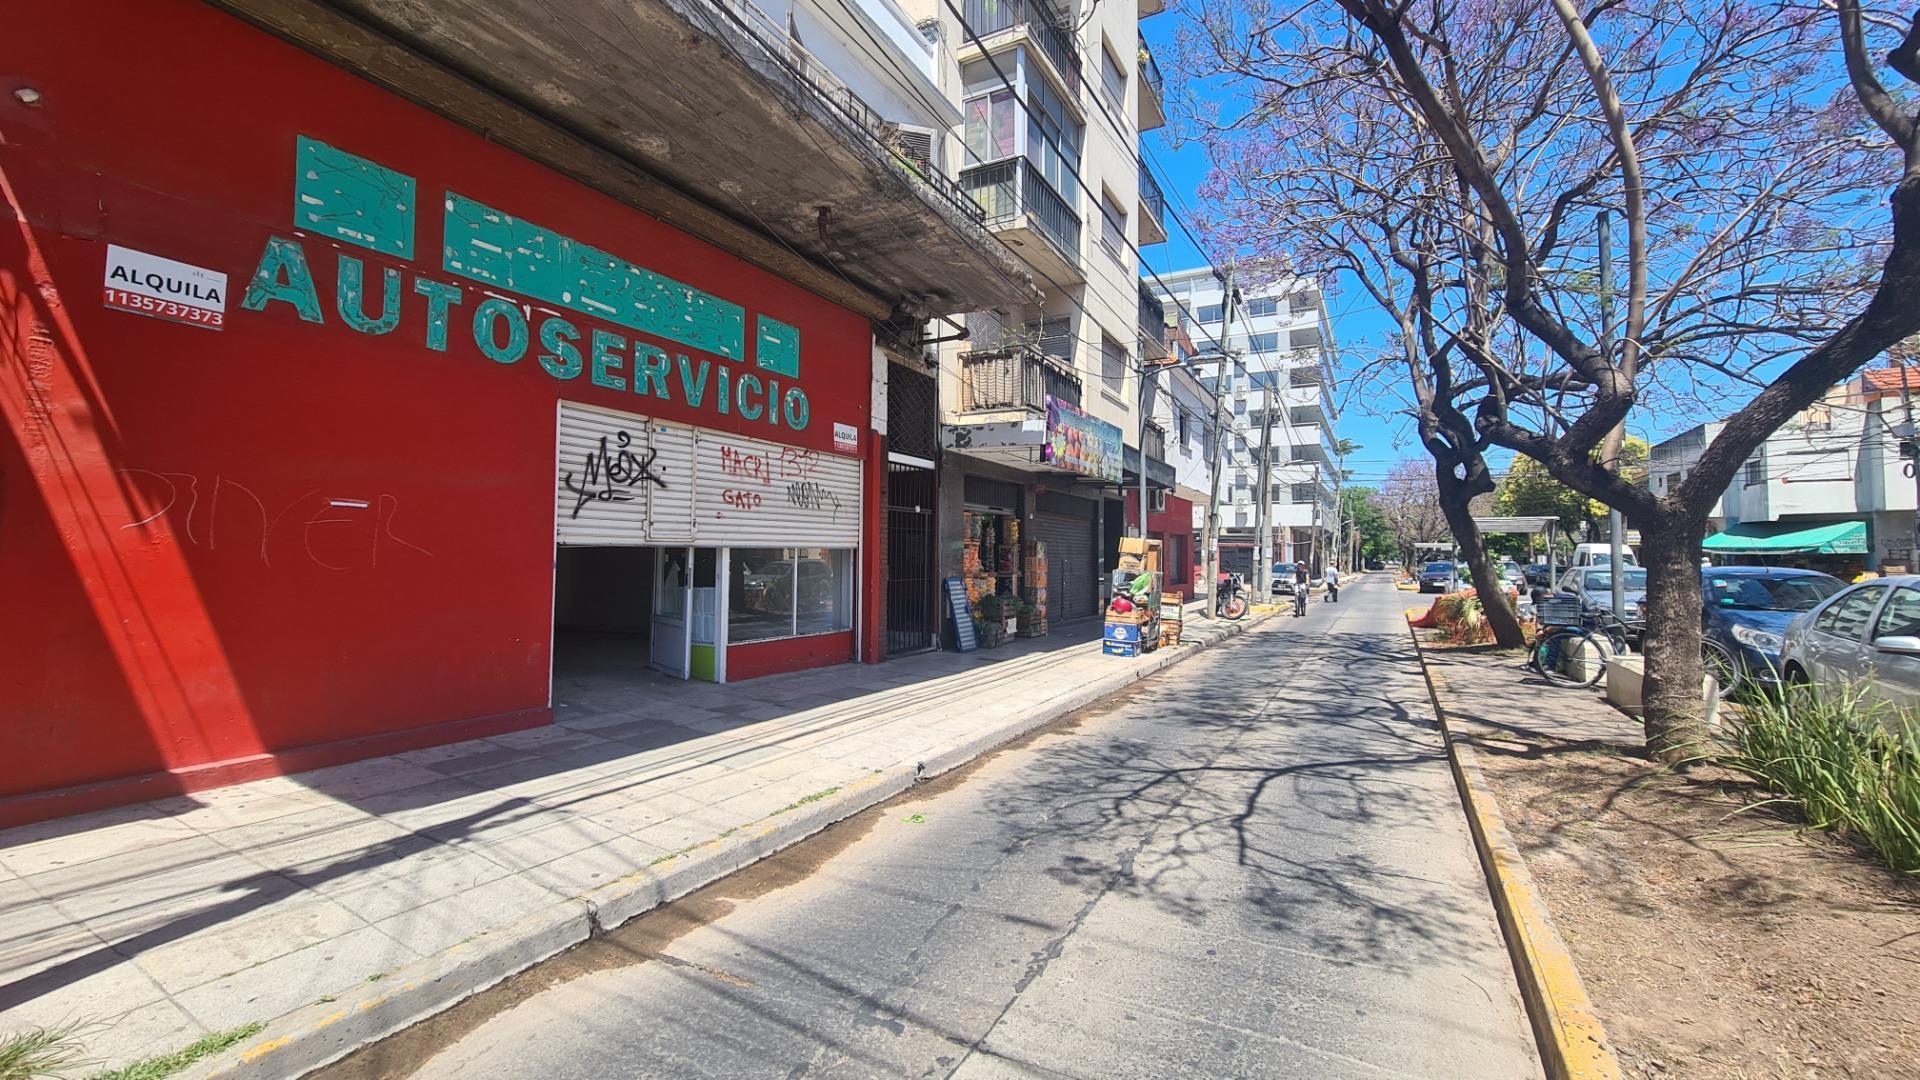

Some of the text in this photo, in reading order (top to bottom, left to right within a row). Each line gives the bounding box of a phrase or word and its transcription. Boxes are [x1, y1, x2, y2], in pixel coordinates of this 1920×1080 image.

[109, 264, 222, 304] ALQUILA
[105, 289, 224, 325] 1135737373
[241, 235, 810, 431] AUTOSERVICIO
[834, 430, 857, 442] ALQUILA
[722, 488, 762, 510] GATO
